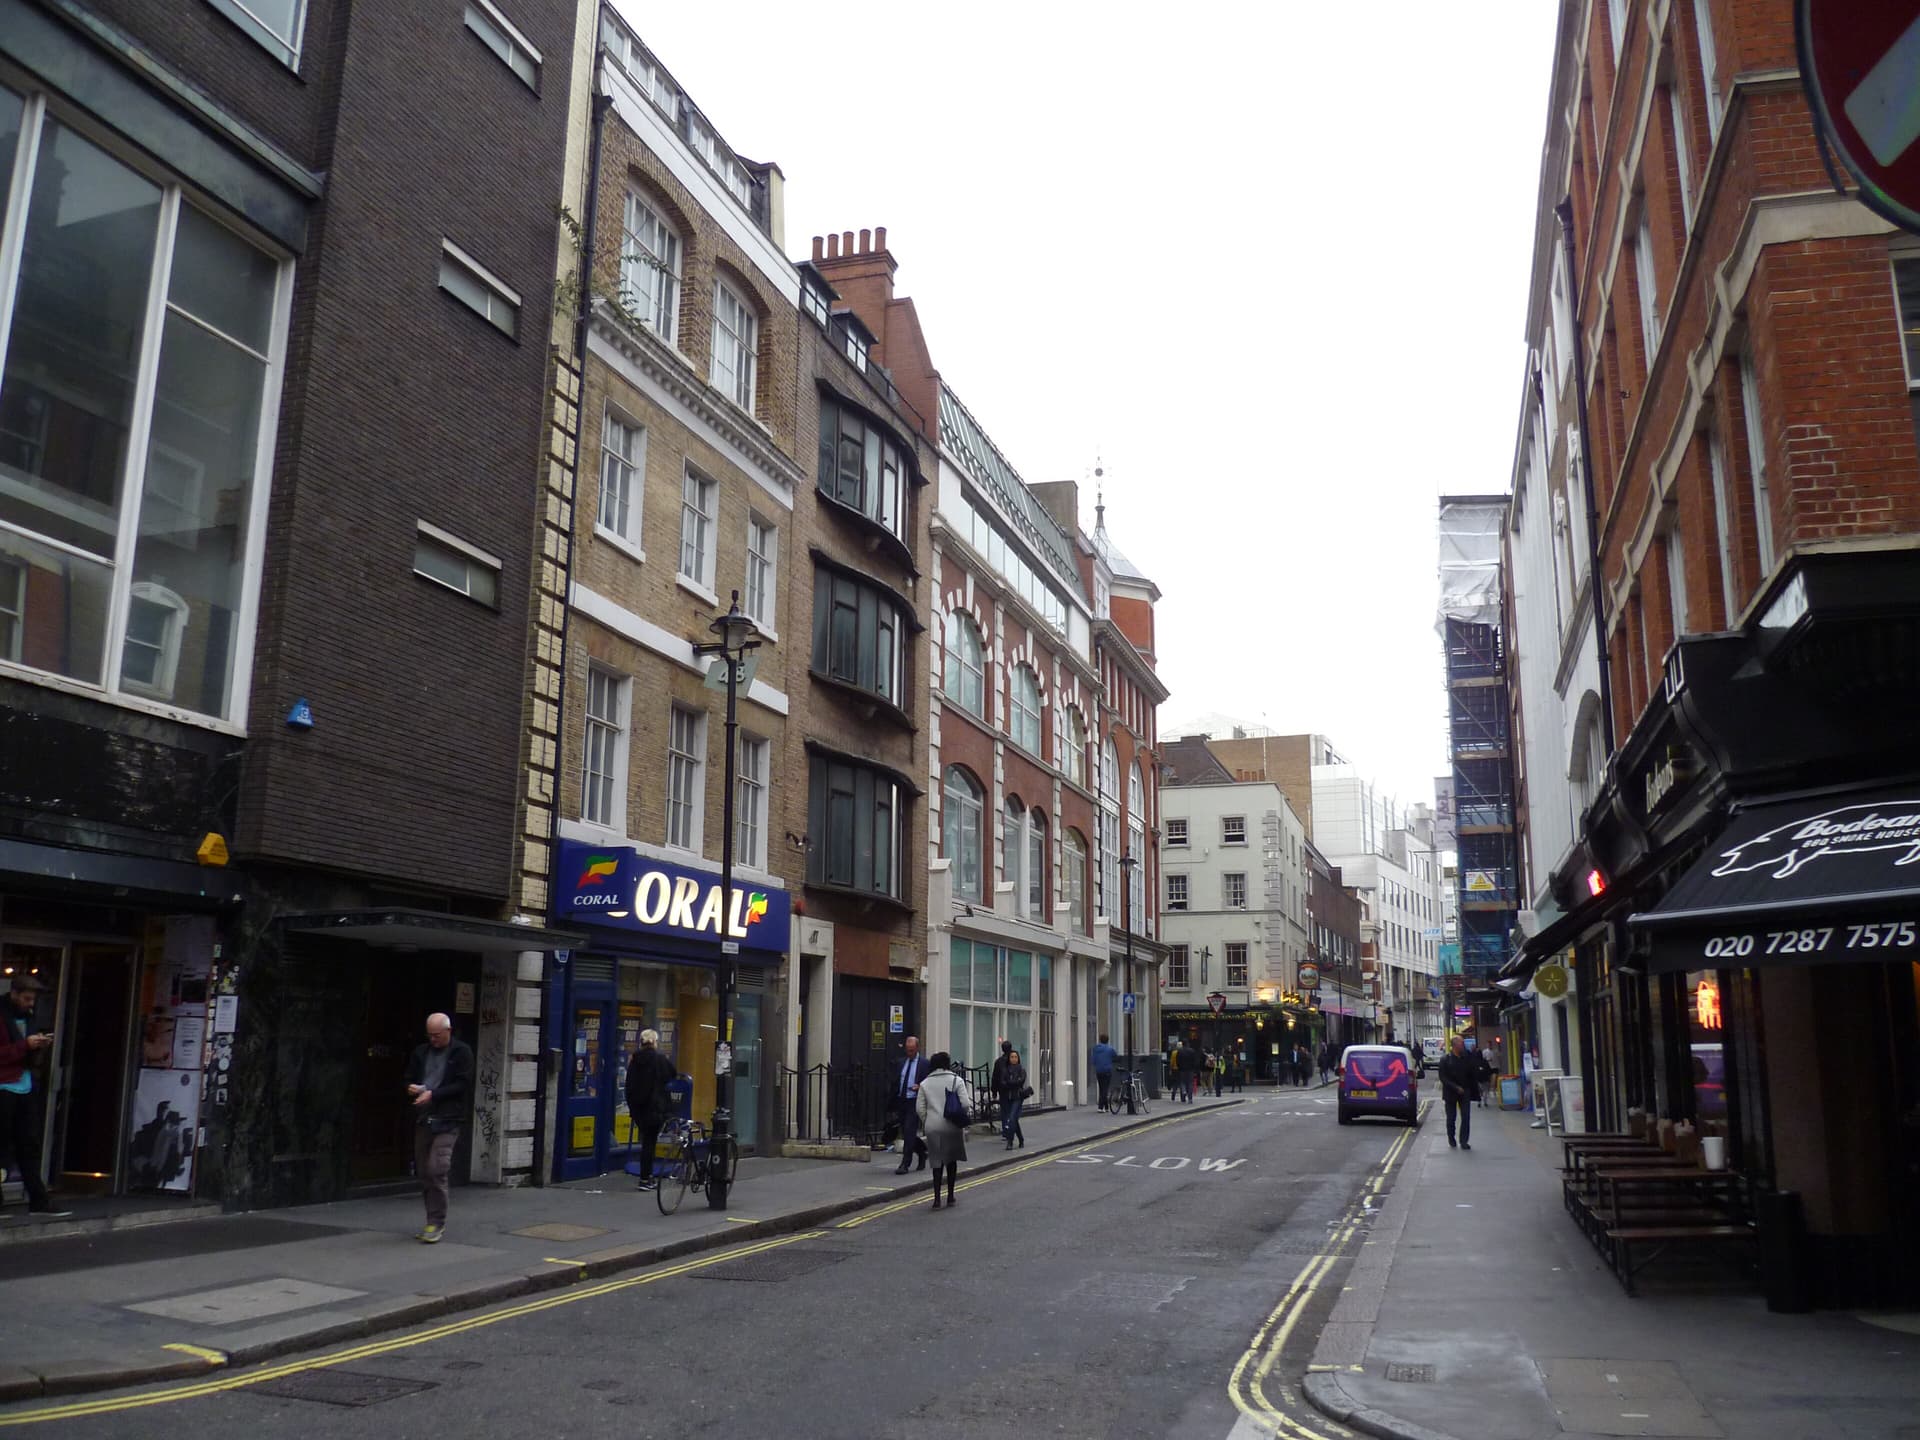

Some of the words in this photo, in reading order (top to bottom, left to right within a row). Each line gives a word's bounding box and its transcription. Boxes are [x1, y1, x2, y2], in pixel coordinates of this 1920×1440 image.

[1830, 832, 1874, 845] SMOKE
[1875, 827, 1920, 839] HOUSE
[573, 893, 619, 906] CORAL
[1704, 935, 1754, 957] 020
[1765, 927, 1834, 954] 7287
[1846, 921, 1916, 948] 7575
[1055, 1153, 1248, 1172] SLOW
